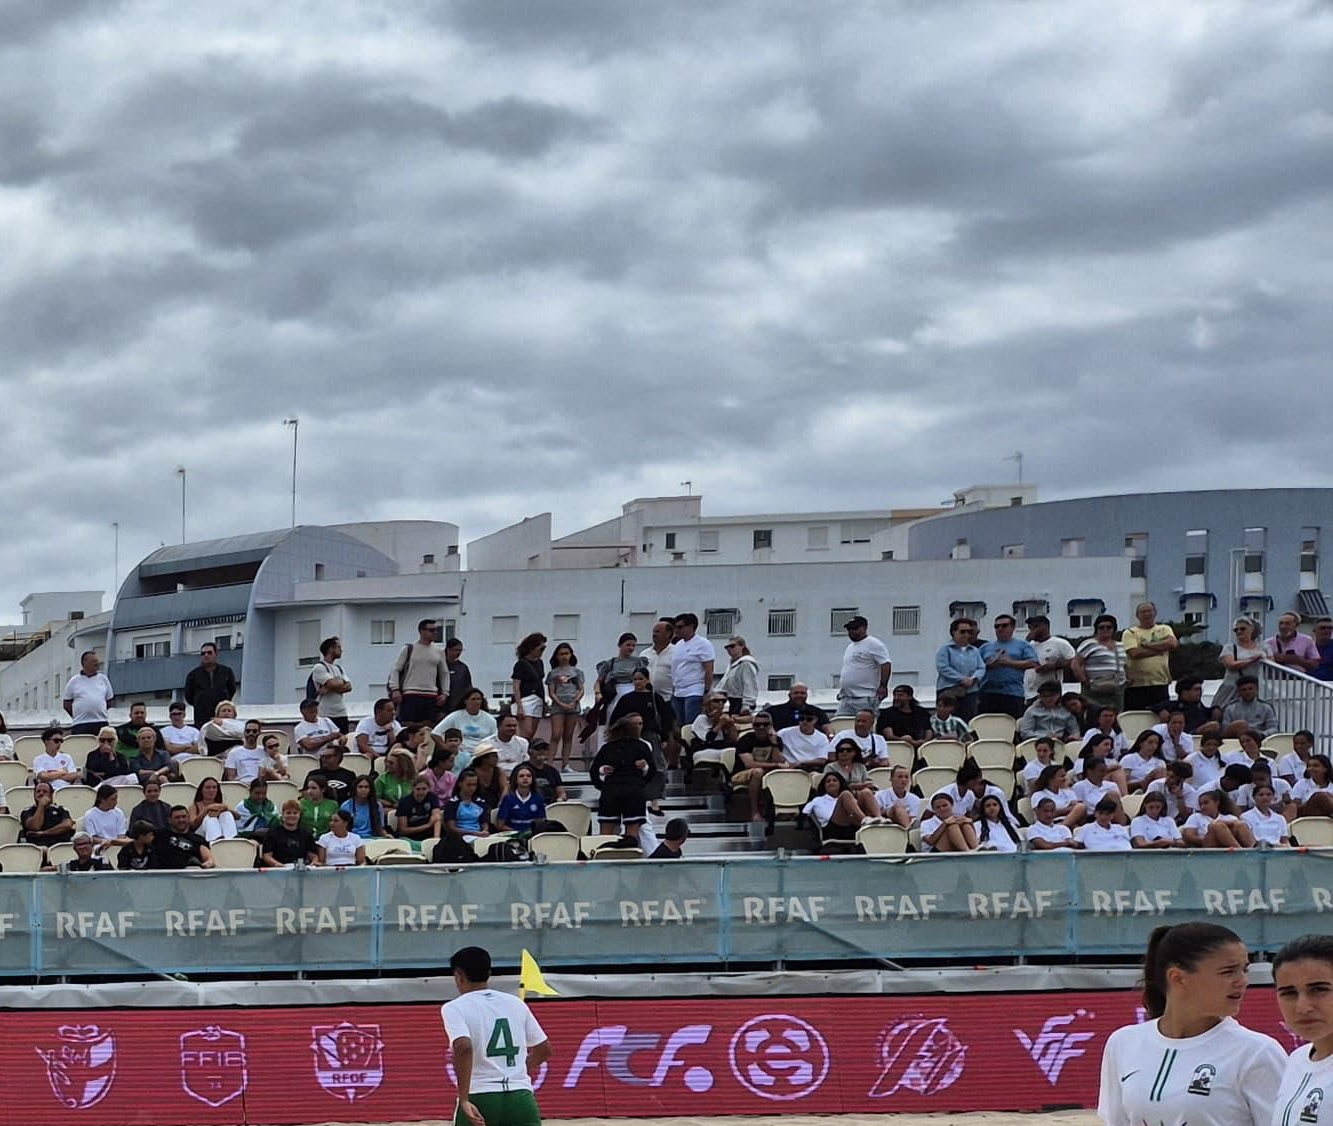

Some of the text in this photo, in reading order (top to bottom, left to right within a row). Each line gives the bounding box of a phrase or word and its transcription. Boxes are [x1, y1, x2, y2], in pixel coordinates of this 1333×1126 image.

[397, 899, 702, 932] RFAF RFAF RFAF
[743, 890, 1053, 924] RFAF RFAF RFAF
[1092, 889, 1172, 916] RFAF
[1203, 888, 1286, 915] RFAF
[56, 906, 358, 939] RFAF RFAF RFAF
[486, 1017, 520, 1068] 4
